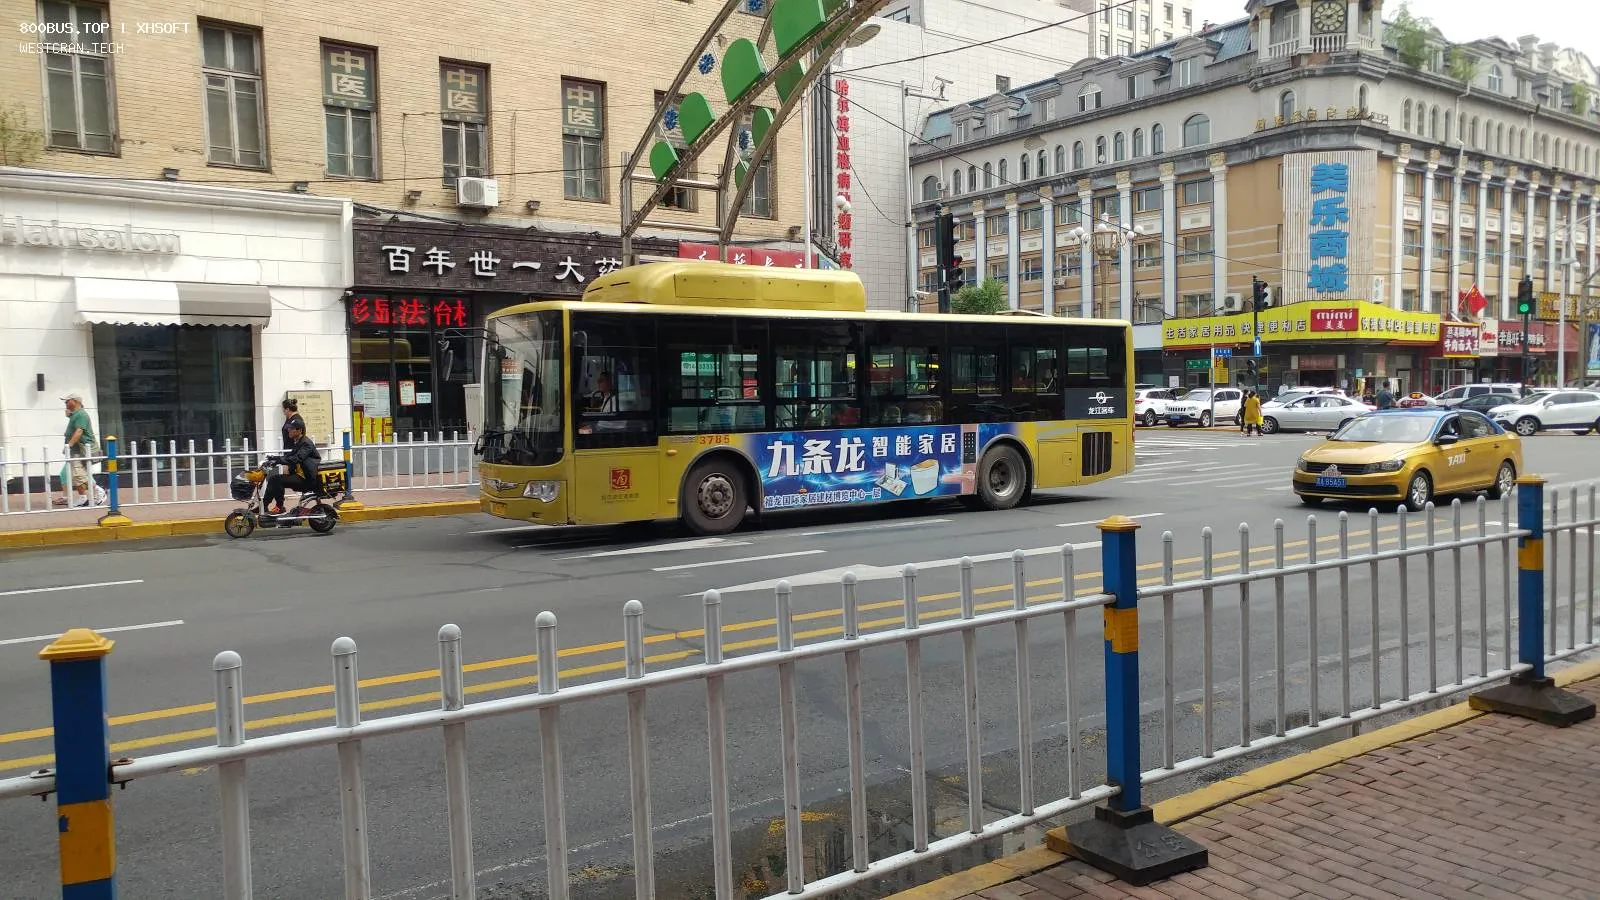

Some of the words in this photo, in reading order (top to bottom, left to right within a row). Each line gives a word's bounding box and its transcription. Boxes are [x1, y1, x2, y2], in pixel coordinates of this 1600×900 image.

[330, 51, 366, 98] 中医
[446, 69, 479, 112] 中医
[566, 85, 596, 127] 中医
[767, 437, 866, 478] 九条龙
[872, 433, 956, 457] 智能家居
[1447, 454, 1467, 466] TAXI
